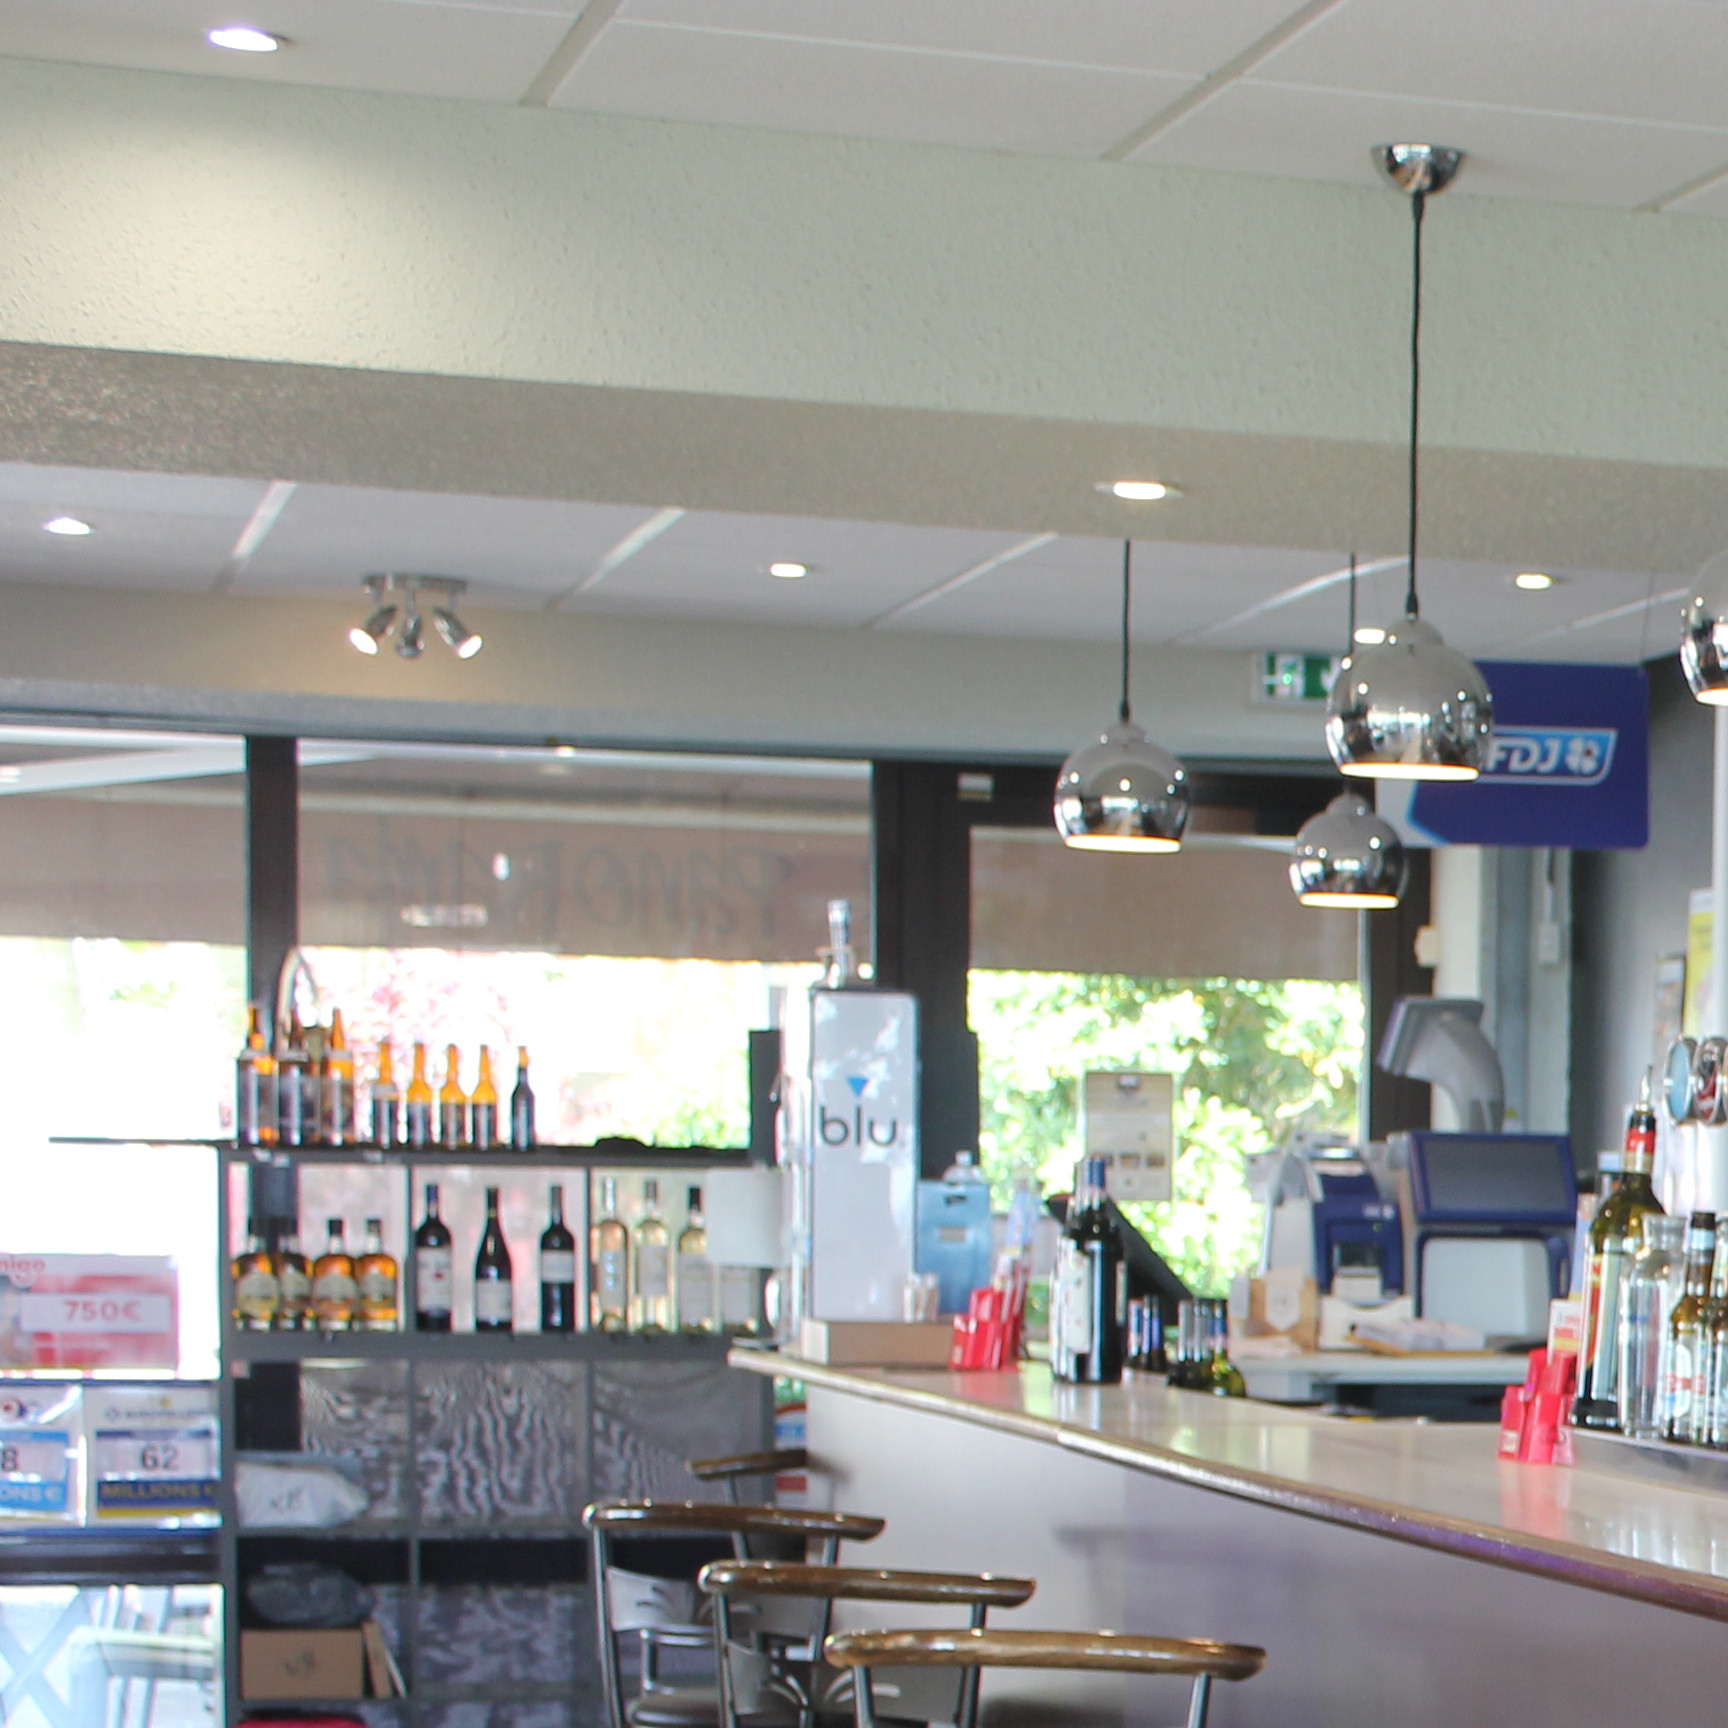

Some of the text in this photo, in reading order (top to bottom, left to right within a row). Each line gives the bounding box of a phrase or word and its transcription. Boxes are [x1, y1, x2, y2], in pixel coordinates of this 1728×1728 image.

[1485, 736, 1560, 774] FDJ
[819, 1104, 897, 1147] blu
[64, 1300, 142, 1322] 750€
[141, 1446, 178, 1471] 62
